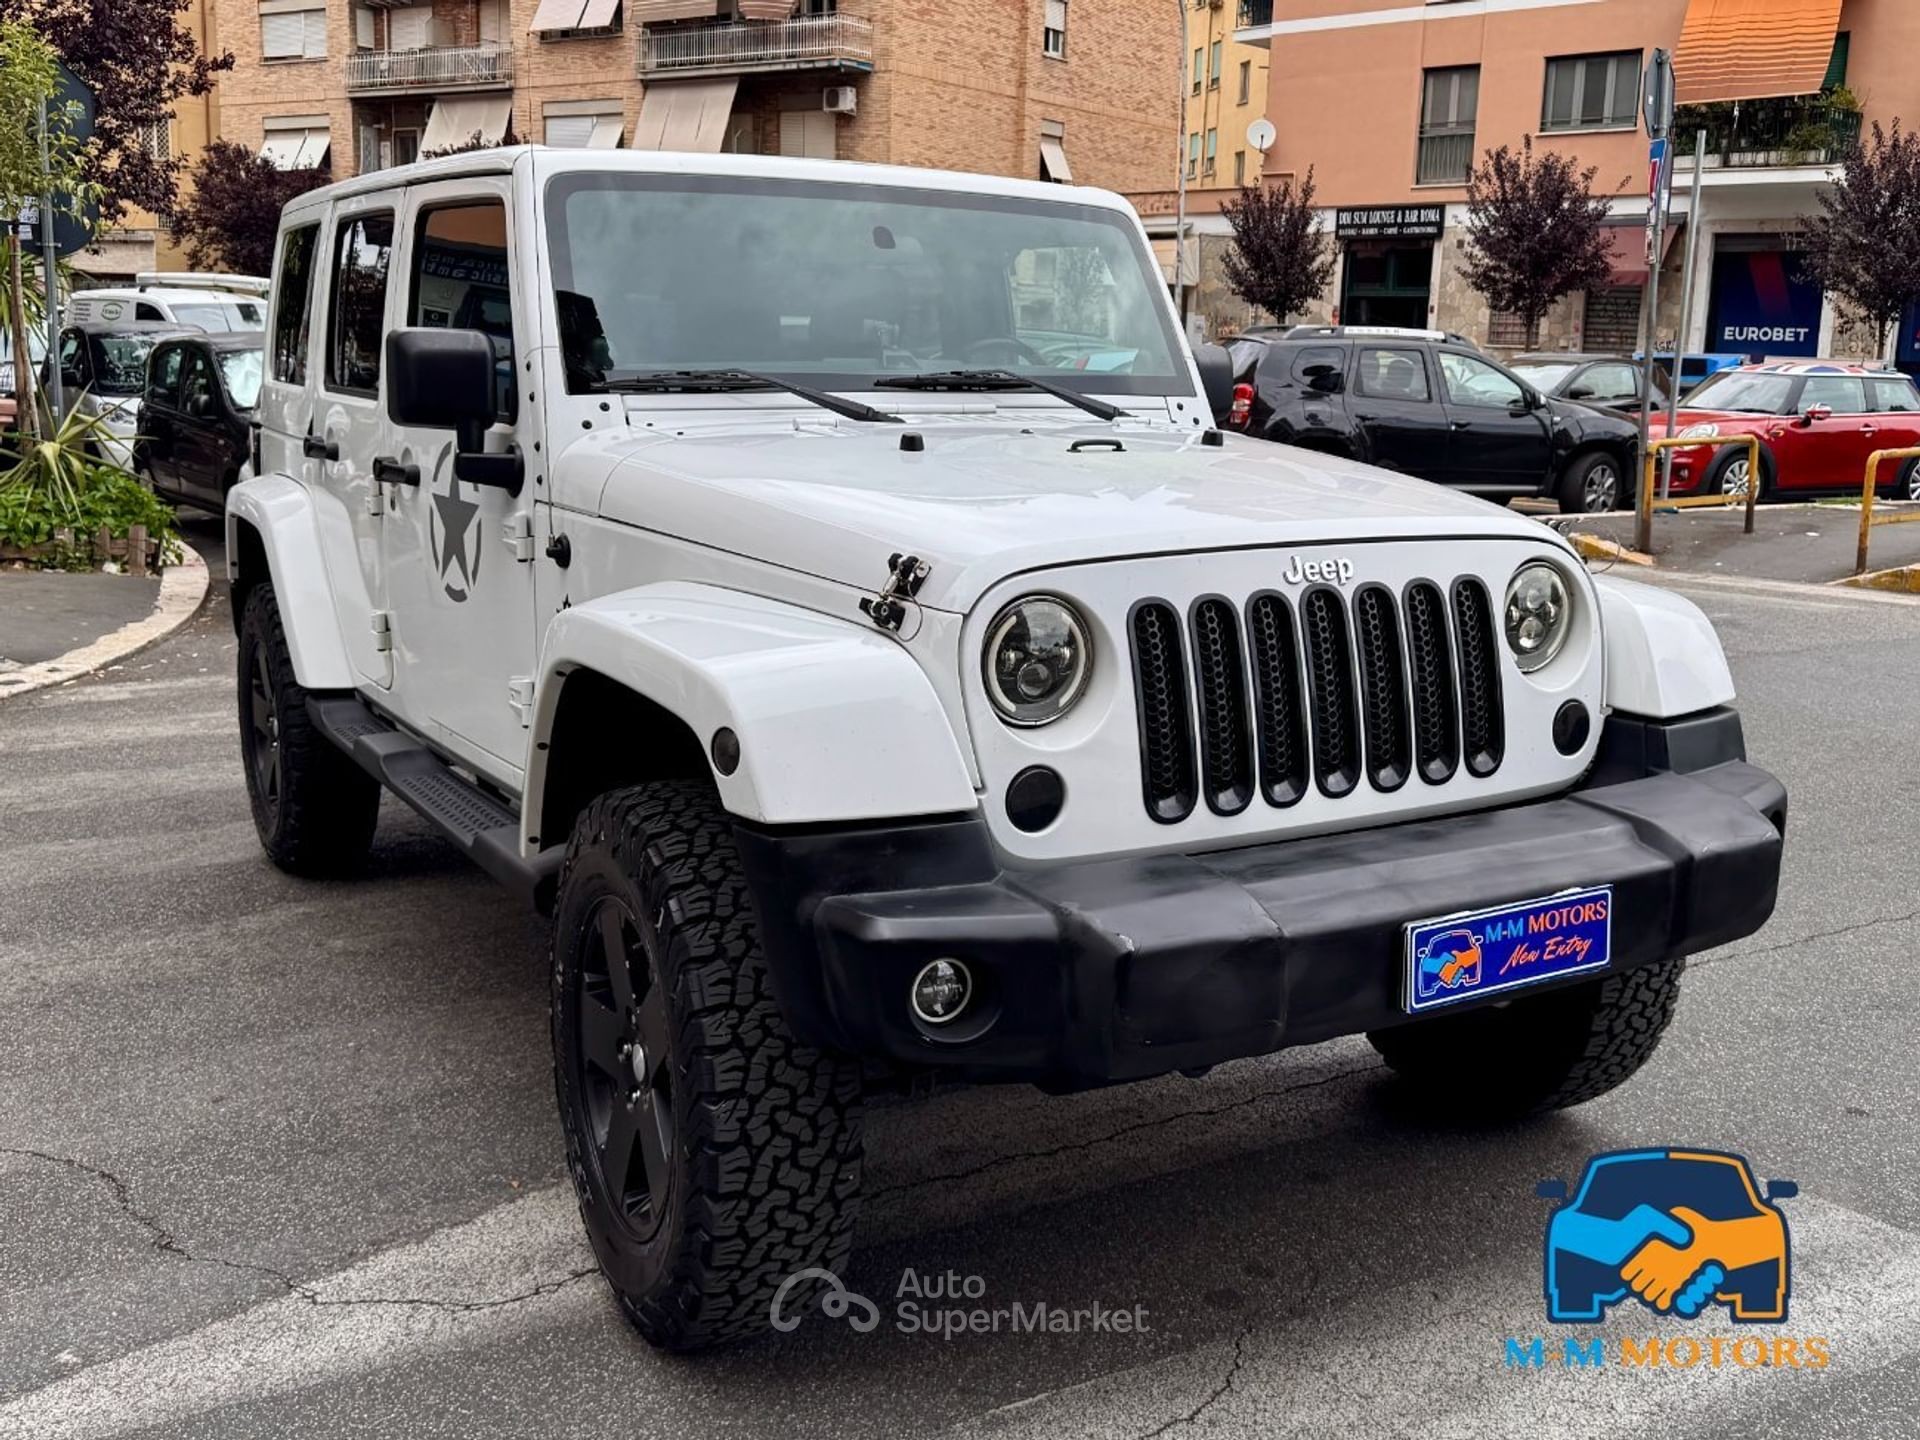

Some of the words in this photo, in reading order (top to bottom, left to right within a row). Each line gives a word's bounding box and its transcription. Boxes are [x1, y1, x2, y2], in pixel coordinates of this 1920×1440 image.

[1353, 211, 1367, 225] SUM
[1369, 210, 1395, 225] LOUNGE
[1404, 209, 1419, 223] BAR
[1420, 208, 1440, 223] ROMA
[1723, 326, 1809, 342] EUROBET
[1282, 555, 1354, 586] Jeep
[1485, 917, 1524, 944] M-M
[1528, 900, 1607, 934] MOTORS
[1499, 943, 1540, 976] New
[1543, 935, 1593, 962] Entry
